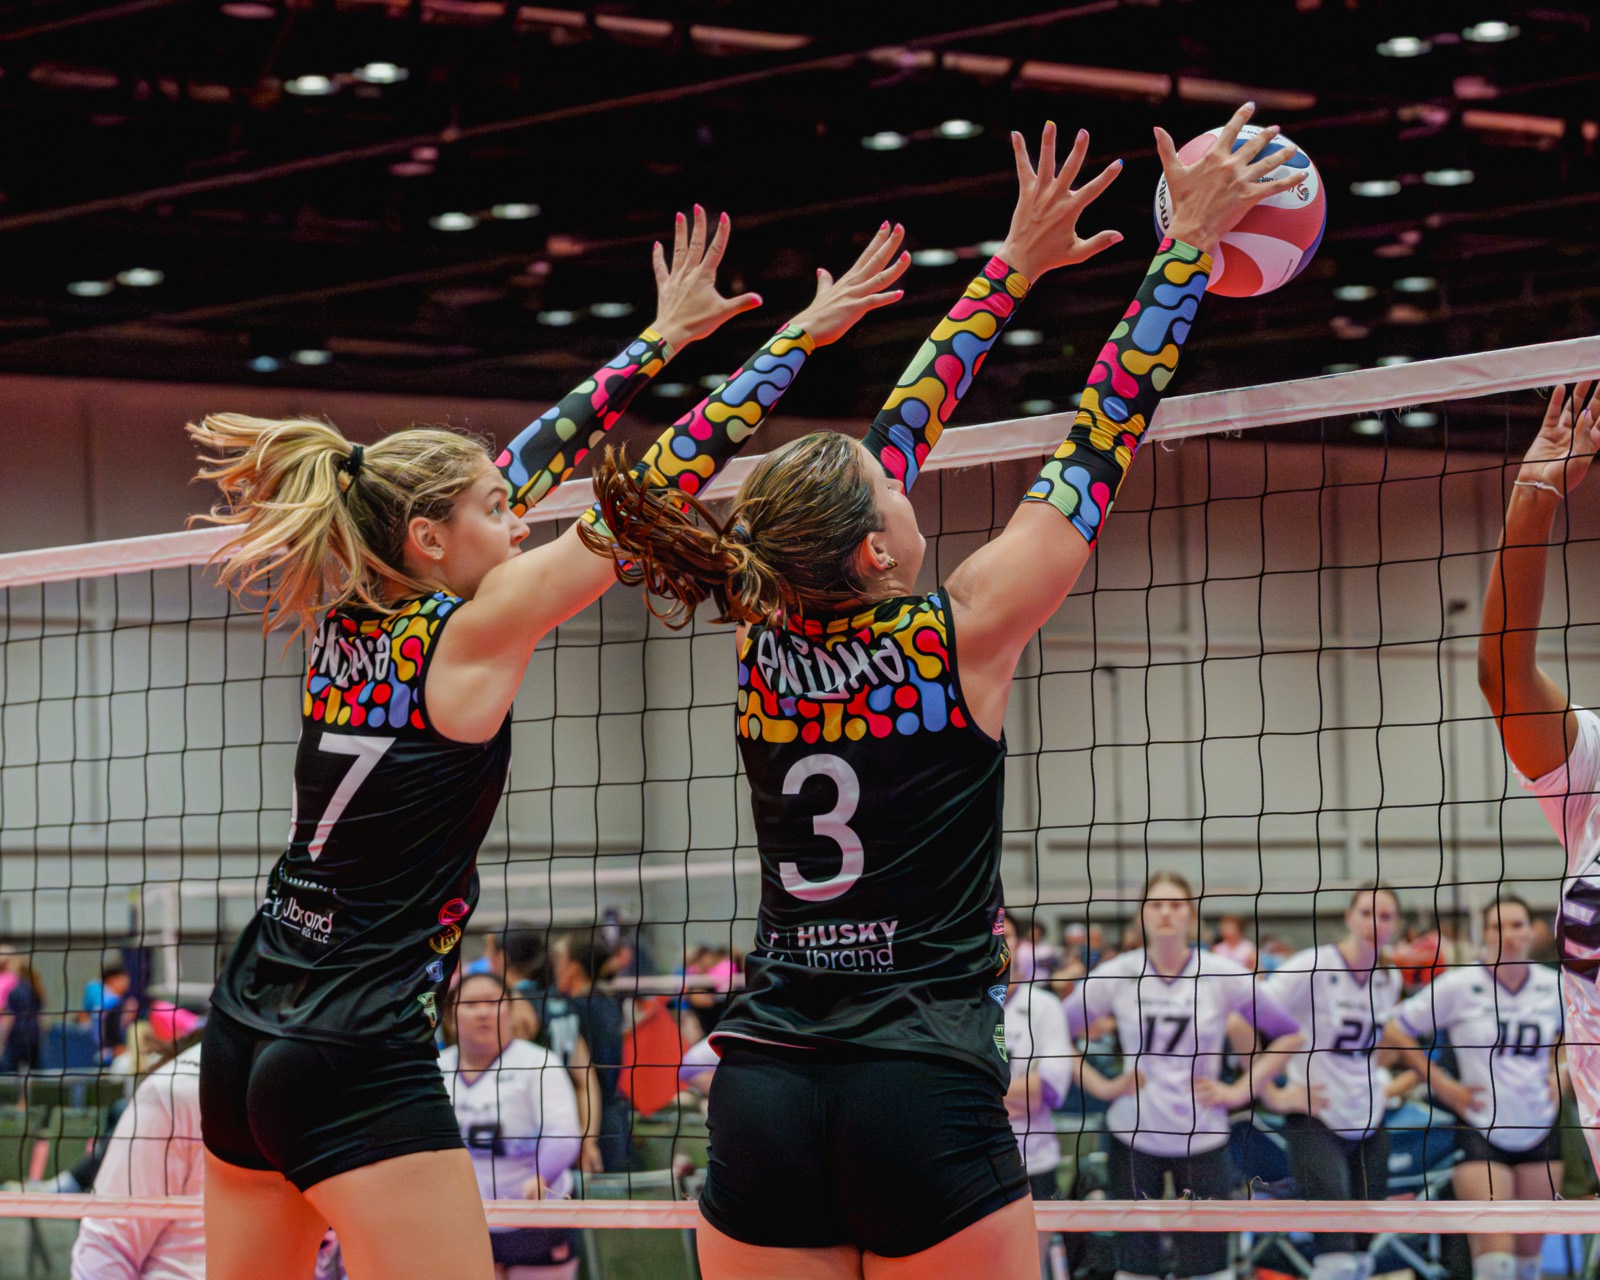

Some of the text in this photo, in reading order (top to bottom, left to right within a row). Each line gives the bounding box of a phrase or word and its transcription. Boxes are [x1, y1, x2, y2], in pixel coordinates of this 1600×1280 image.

[308, 731, 396, 862] 7
[779, 753, 864, 901] 3
[797, 920, 898, 947] HUSKY
[1144, 1015, 1192, 1053] 17
[1498, 1021, 1541, 1057] 10
